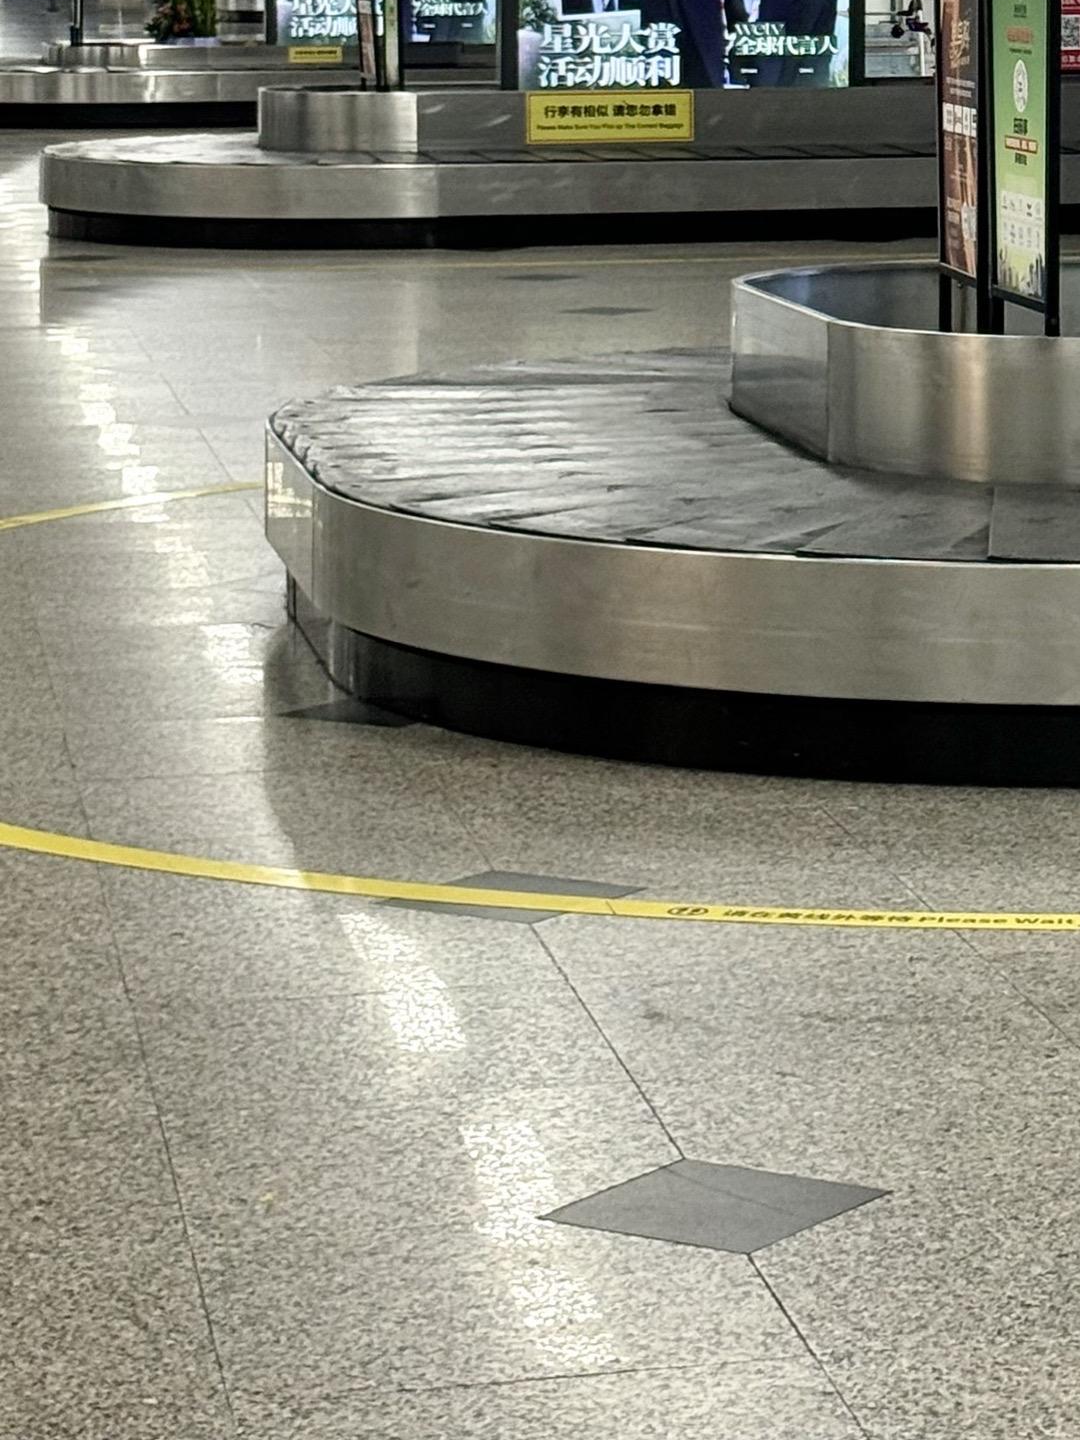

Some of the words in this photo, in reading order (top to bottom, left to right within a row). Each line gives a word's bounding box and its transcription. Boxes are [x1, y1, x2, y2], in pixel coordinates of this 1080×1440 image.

[539, 22, 682, 55] 星光大赏
[735, 35, 839, 56] 全球代言人
[538, 55, 682, 88] 活动顺利
[918, 915, 1009, 924] Please
[1015, 916, 1074, 925] Wait
